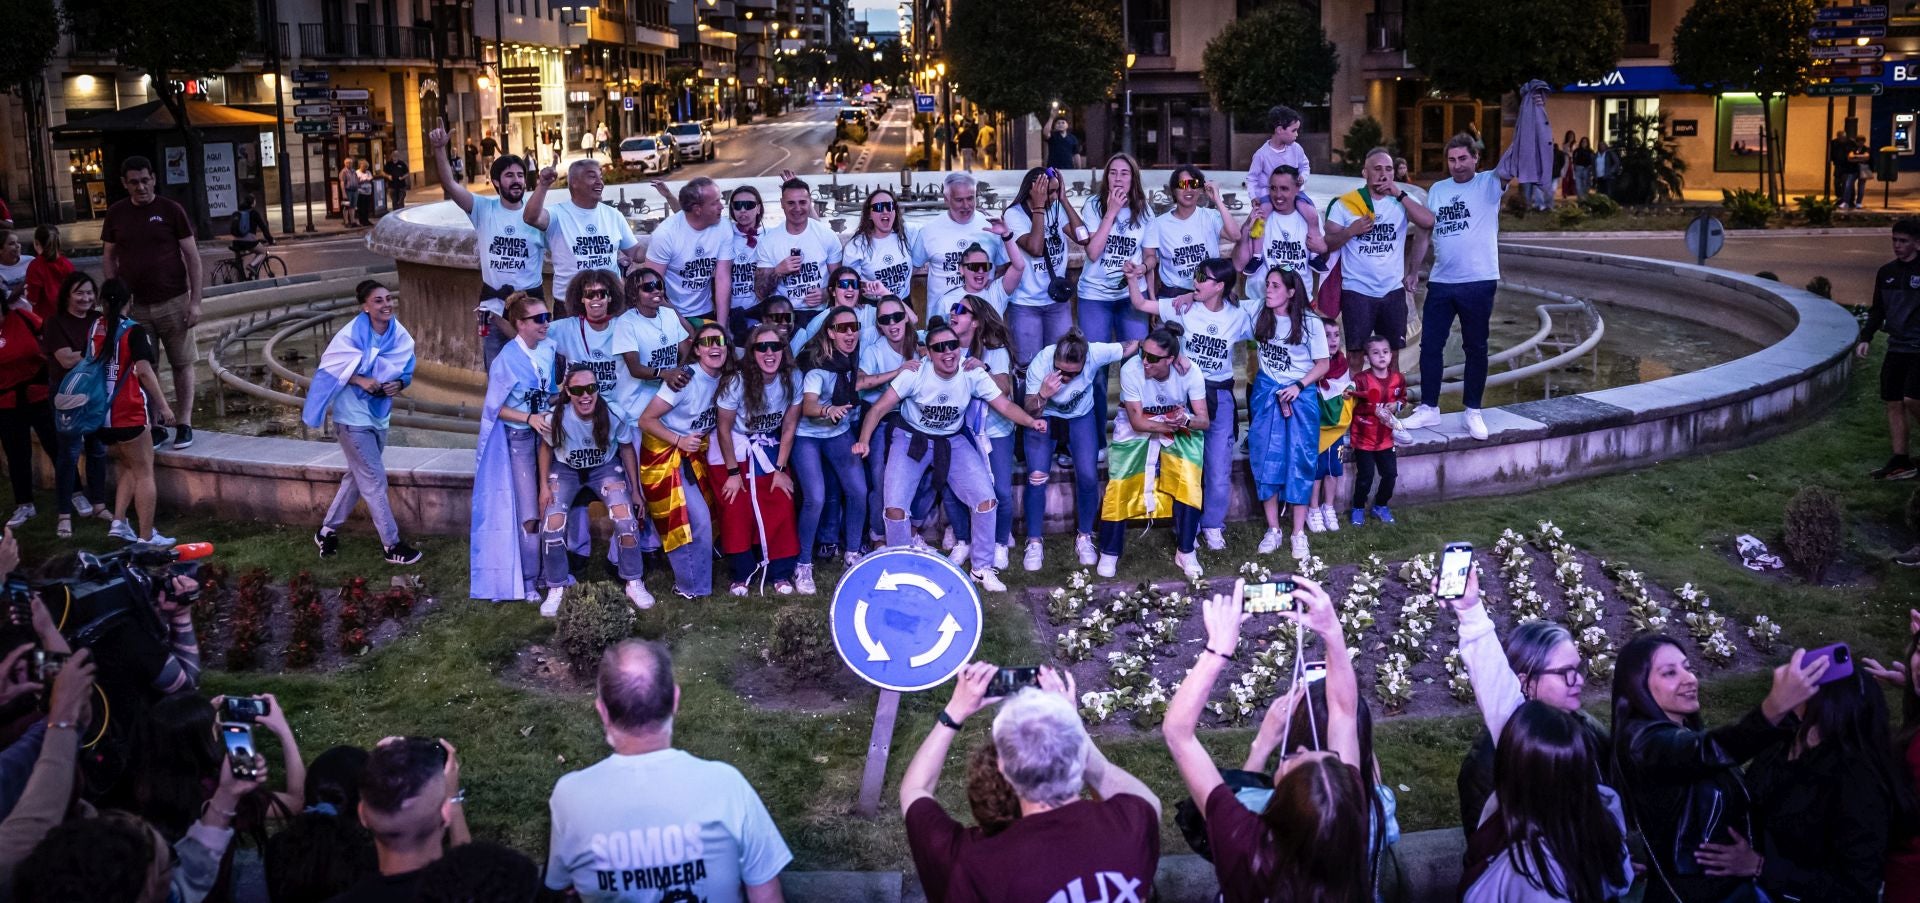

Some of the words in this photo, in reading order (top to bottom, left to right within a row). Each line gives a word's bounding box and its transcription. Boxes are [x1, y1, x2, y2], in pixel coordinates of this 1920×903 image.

[920, 97, 932, 105] VP
[493, 235, 527, 248] SOMOS
[576, 235, 610, 246] SOMOS
[1107, 234, 1137, 247] SOMOS
[1271, 240, 1302, 250] SOMOS
[1174, 243, 1206, 256] SOMOS
[684, 257, 718, 271] SOMOS
[874, 262, 909, 280] SOMOS
[946, 275, 966, 286] PRIM
[1191, 333, 1228, 350] SOMOS
[650, 343, 678, 361] SOMOS
[924, 405, 959, 415] SOMOS
[570, 448, 607, 460] SOMOS
[591, 822, 703, 871] SOMOS
[597, 869, 618, 892] DE
[622, 858, 707, 892] PRIMERA
